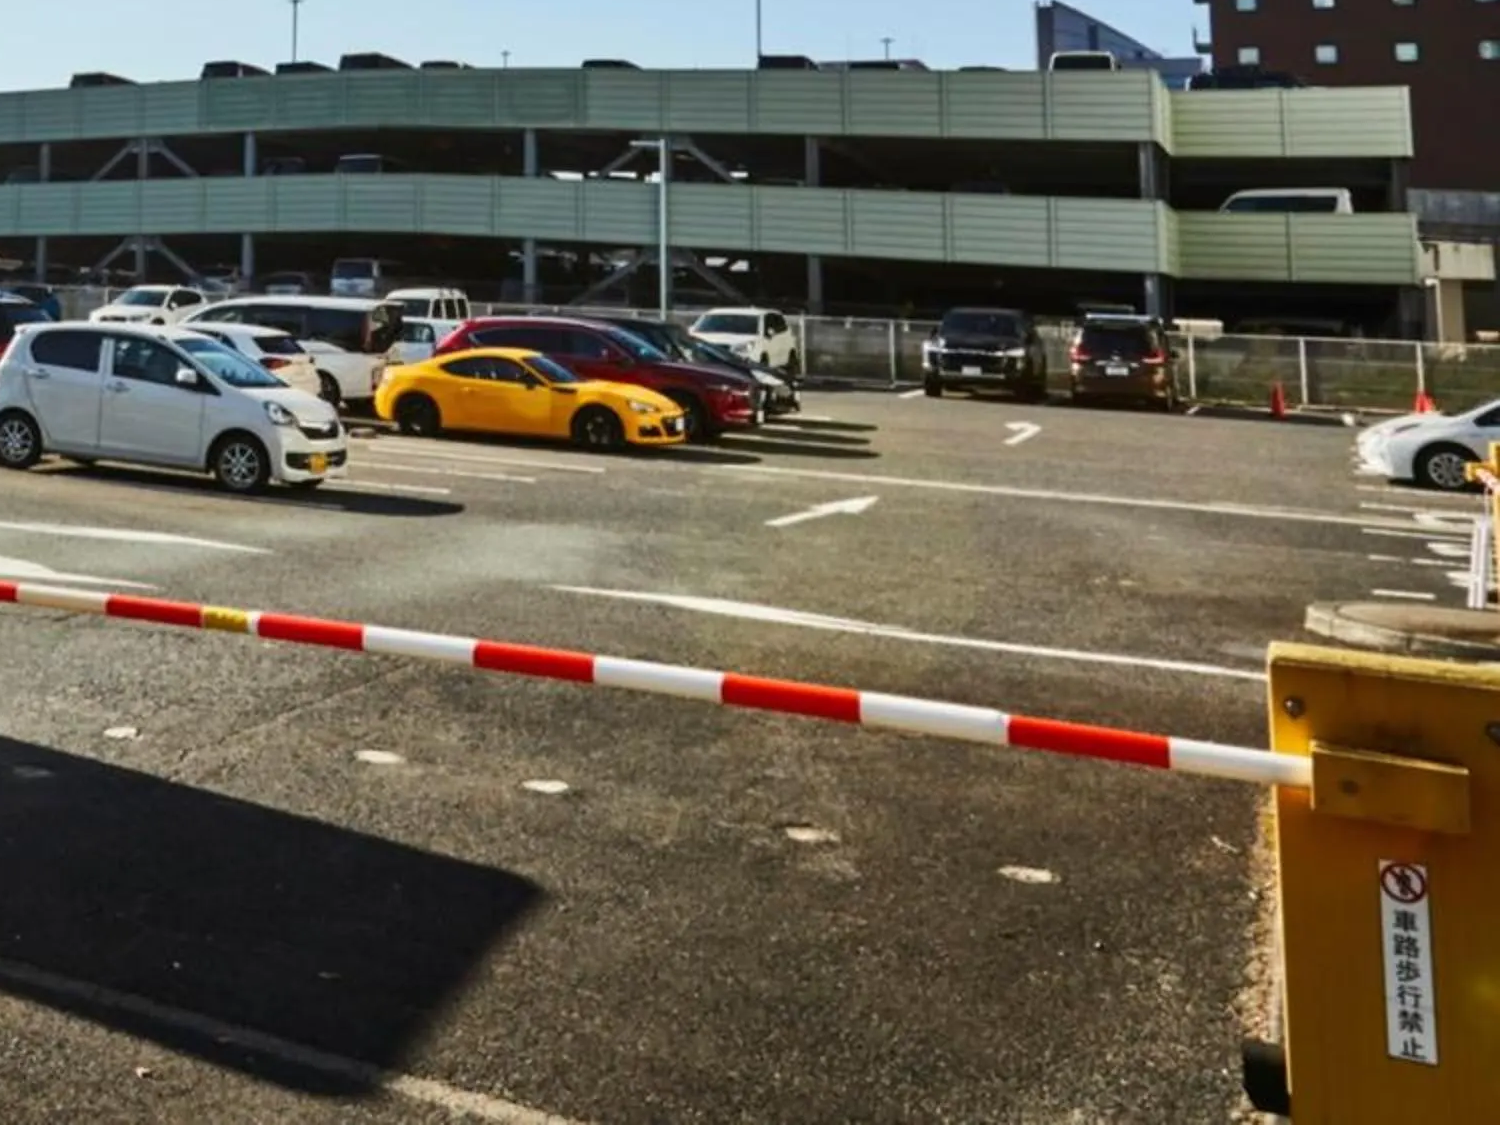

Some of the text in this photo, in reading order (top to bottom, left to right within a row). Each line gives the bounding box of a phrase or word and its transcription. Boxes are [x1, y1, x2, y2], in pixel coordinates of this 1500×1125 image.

[1392, 908, 1427, 1061] 車路歩行禁止
